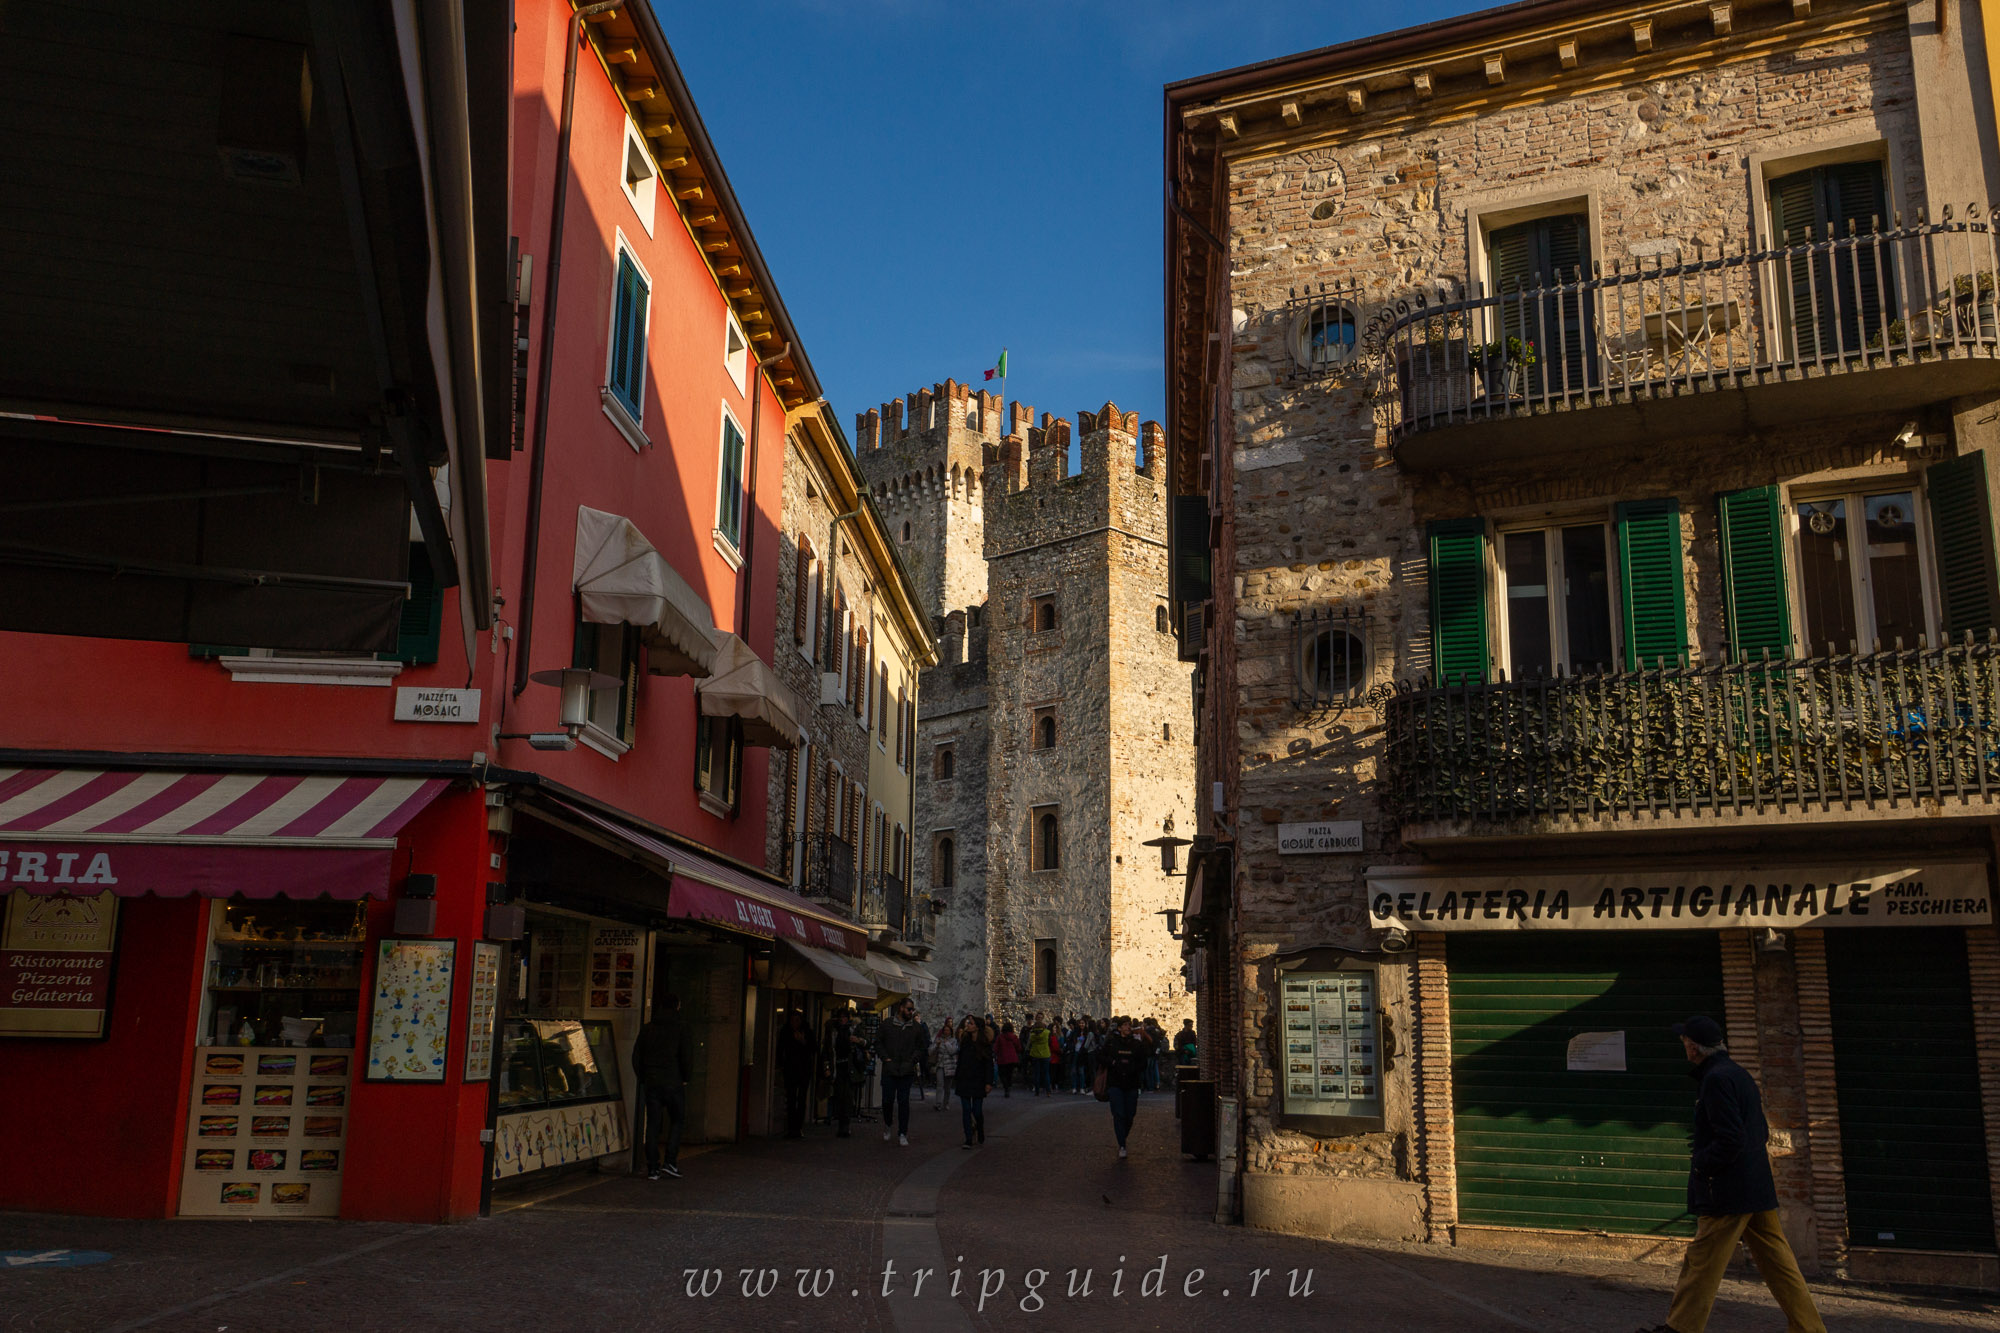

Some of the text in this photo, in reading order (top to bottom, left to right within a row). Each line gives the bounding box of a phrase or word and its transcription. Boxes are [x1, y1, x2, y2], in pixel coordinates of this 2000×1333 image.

[418, 693, 457, 702] PIAZZETTA
[413, 704, 461, 716] MOSAICI
[1308, 827, 1332, 835] PIAZZA
[1318, 836, 1360, 848] CARDUCCI
[1884, 882, 1929, 898] FAM.
[1372, 883, 1872, 921] GELATERIA ARTIGIANALE
[1887, 898, 1988, 915] PESCHIERA
[594, 937, 639, 946] GARDEN
[9, 955, 105, 969] Ristorante
[17, 972, 92, 985] Pizzeria
[11, 987, 94, 1004] Gelateria
